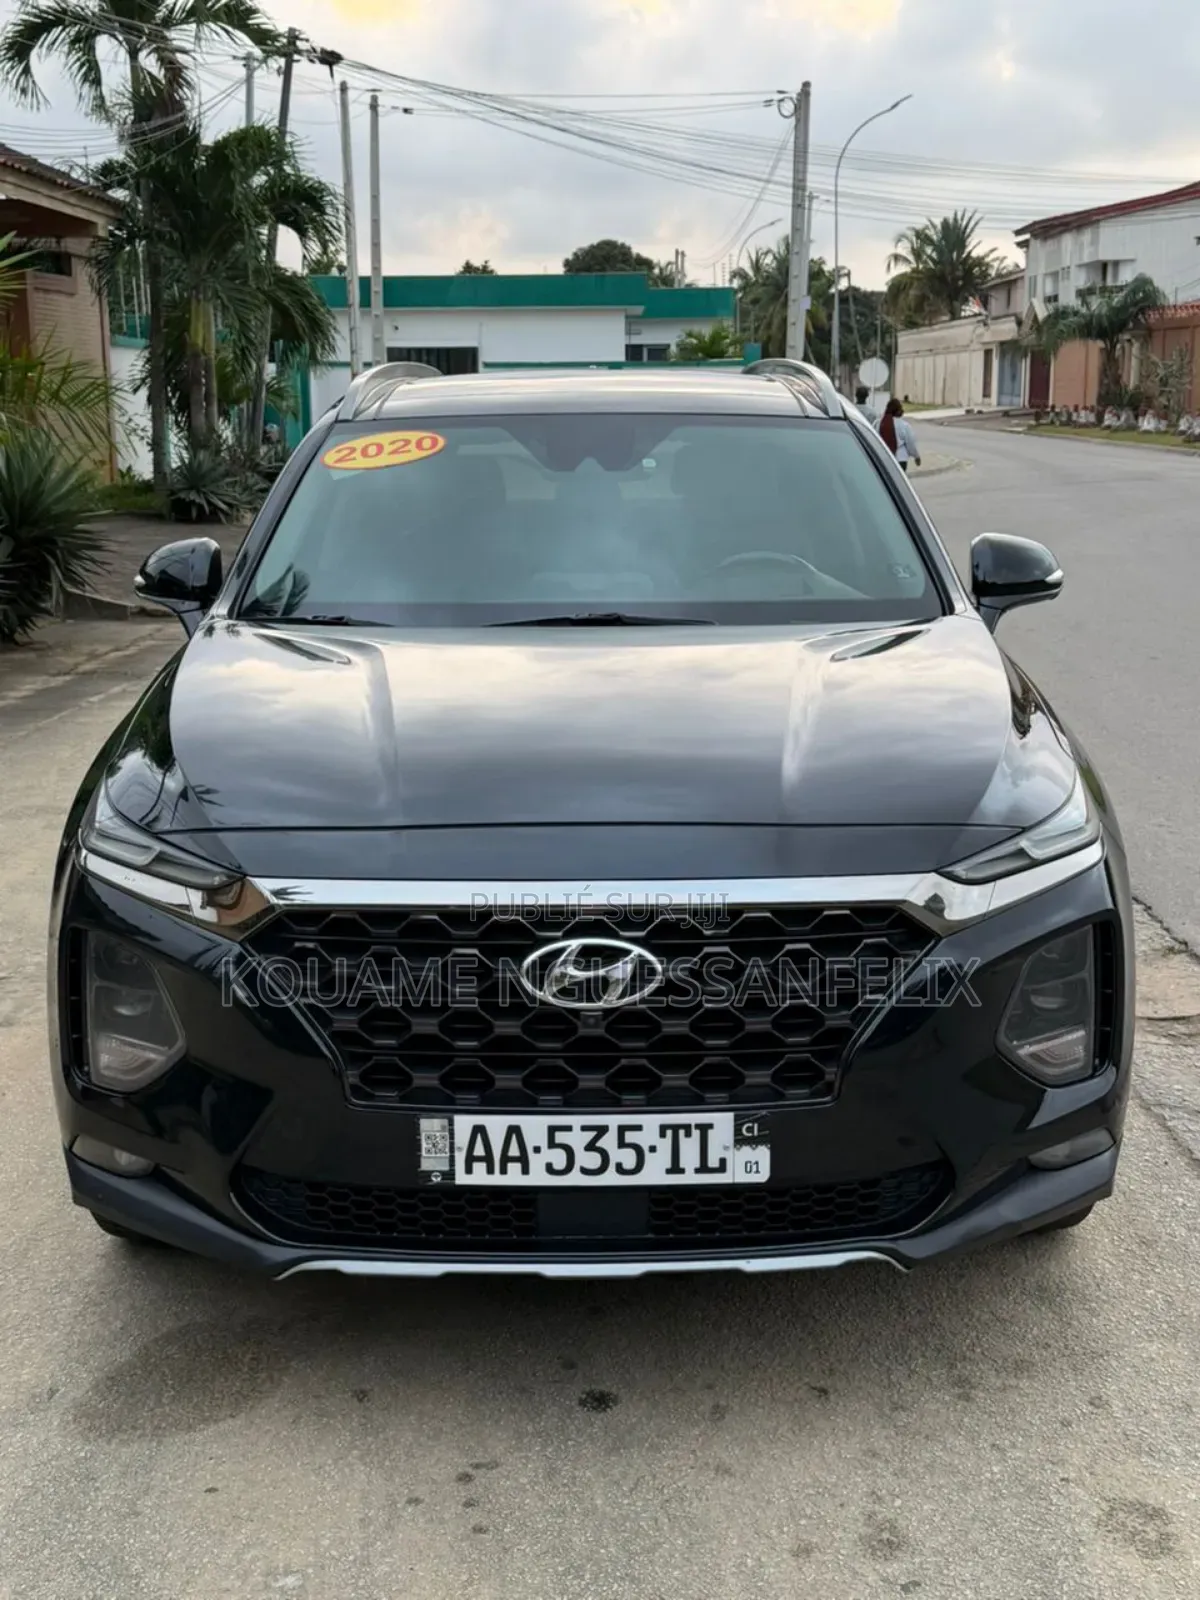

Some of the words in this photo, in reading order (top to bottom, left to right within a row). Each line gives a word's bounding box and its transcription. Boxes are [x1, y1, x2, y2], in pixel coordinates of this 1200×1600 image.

[332, 435, 439, 464] 2020
[742, 1123, 758, 1136] CI
[744, 1160, 761, 1174] 01
